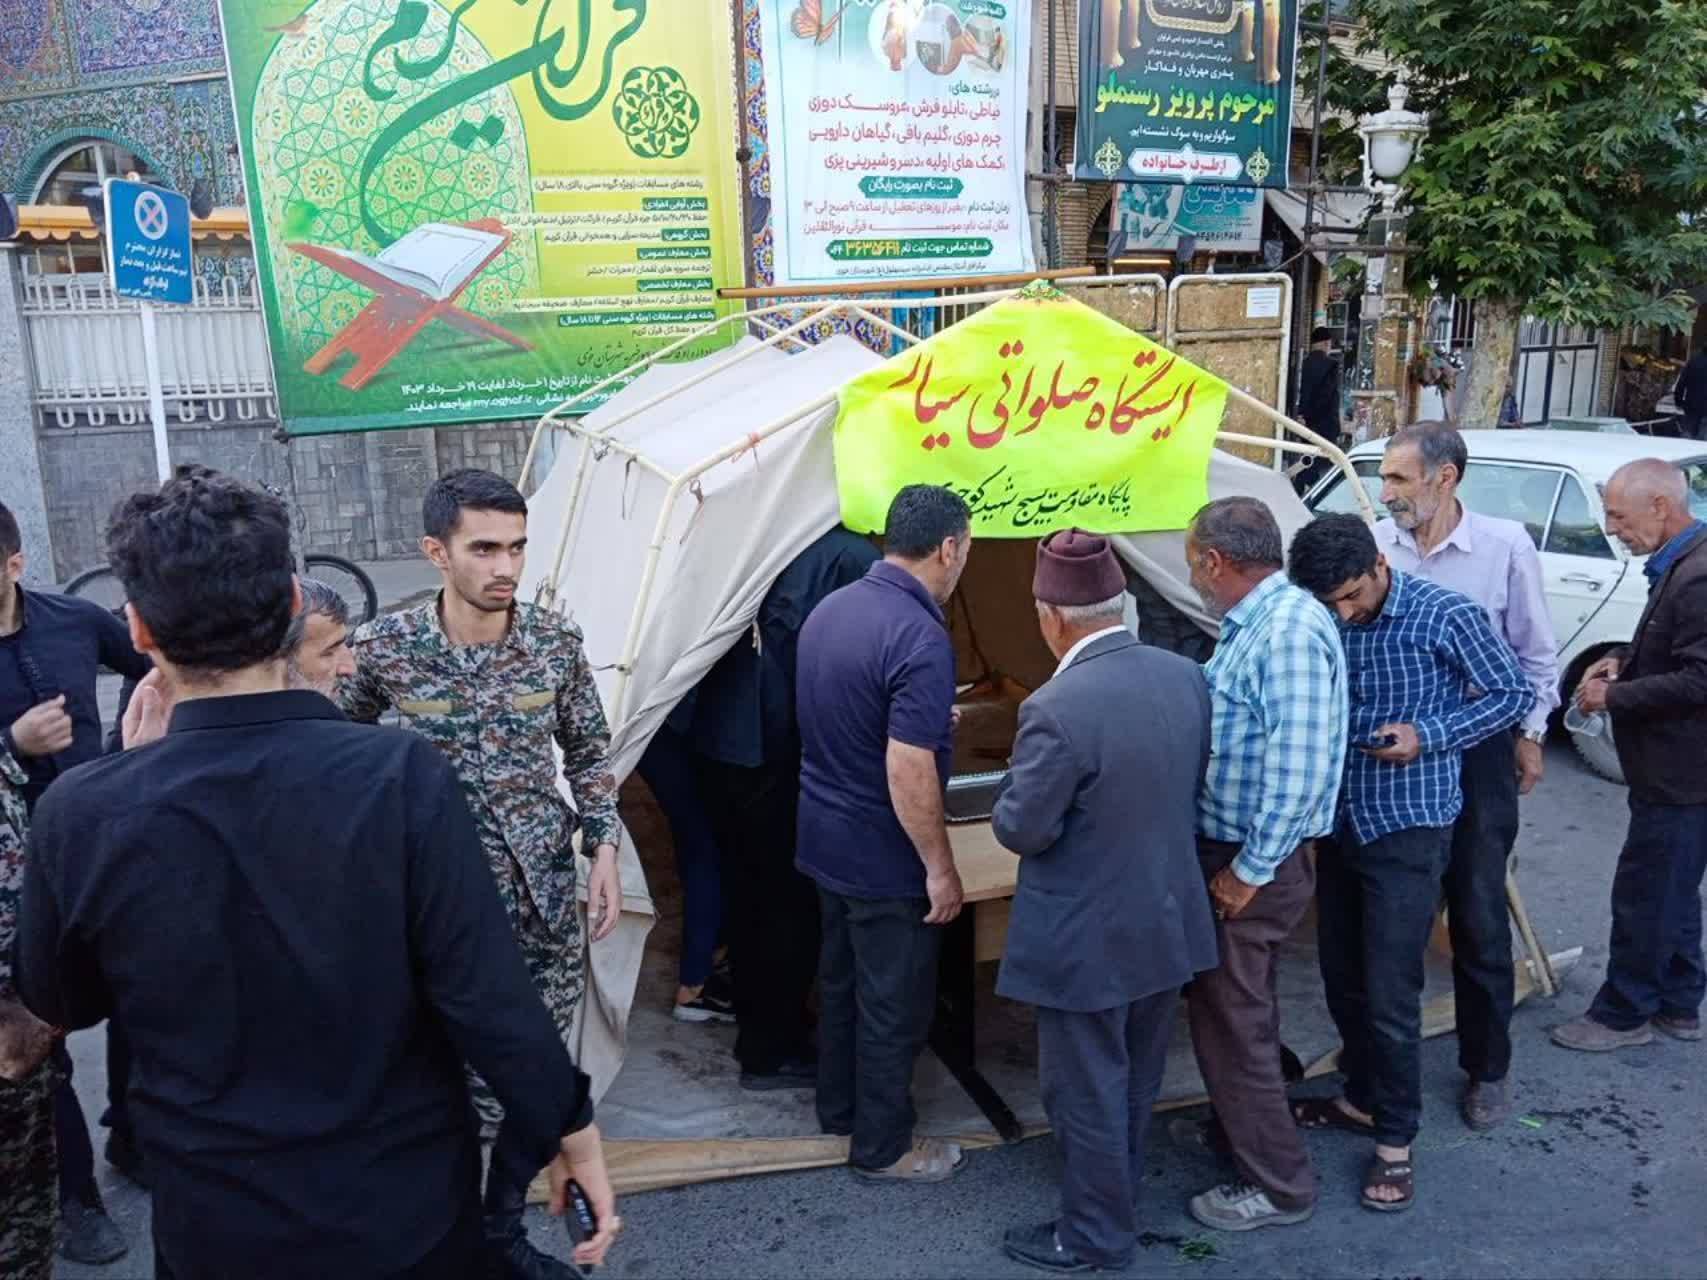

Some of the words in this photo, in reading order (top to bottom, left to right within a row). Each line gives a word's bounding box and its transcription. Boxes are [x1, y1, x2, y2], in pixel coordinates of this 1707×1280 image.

[1184, 64, 1208, 78] مهربان
[1095, 70, 1161, 117] رستملو
[808, 96, 837, 113] دوزی
[912, 97, 940, 117] فرش
[1164, 85, 1215, 121] پرویز
[1219, 90, 1276, 124] مرحوم
[809, 122, 850, 142] دارویی
[896, 124, 921, 144] بافی
[953, 132, 979, 146] دوزی
[1205, 129, 1236, 144] سوگواریم
[981, 133, 1001, 148] چرم
[824, 155, 845, 170] پزی
[846, 152, 889, 171] شیرینی
[926, 152, 950, 169] اولیه
[951, 153, 974, 171] های
[1142, 155, 1186, 173] خانواده
[867, 179, 894, 193] رایگان
[894, 181, 923, 193] بصورت
[923, 180, 936, 192] نام
[936, 179, 954, 191] ثبت
[828, 204, 849, 216] صبح
[856, 200, 881, 211] ساعت
[981, 200, 995, 211] ثبت
[994, 200, 1009, 214] زمان
[977, 219, 992, 230] ثبت
[901, 241, 912, 256] نام
[912, 242, 928, 252] ثبت
[927, 243, 946, 254] جهت
[946, 241, 969, 254] تماس
[477, 377, 506, 393] لغایت
[511, 376, 544, 391] خرداد
[549, 376, 571, 390] تاریخ
[579, 375, 592, 387] نام
[426, 382, 466, 396] خرداد
[967, 340, 1100, 449] صلواتی
[1085, 350, 1199, 442] ایستگاه
[888, 352, 971, 451] سیار
[971, 477, 1019, 522] شهید
[1037, 483, 1099, 513] مقاومت
[1098, 477, 1131, 517] پایگاه
[1012, 488, 1053, 527] بسیج
